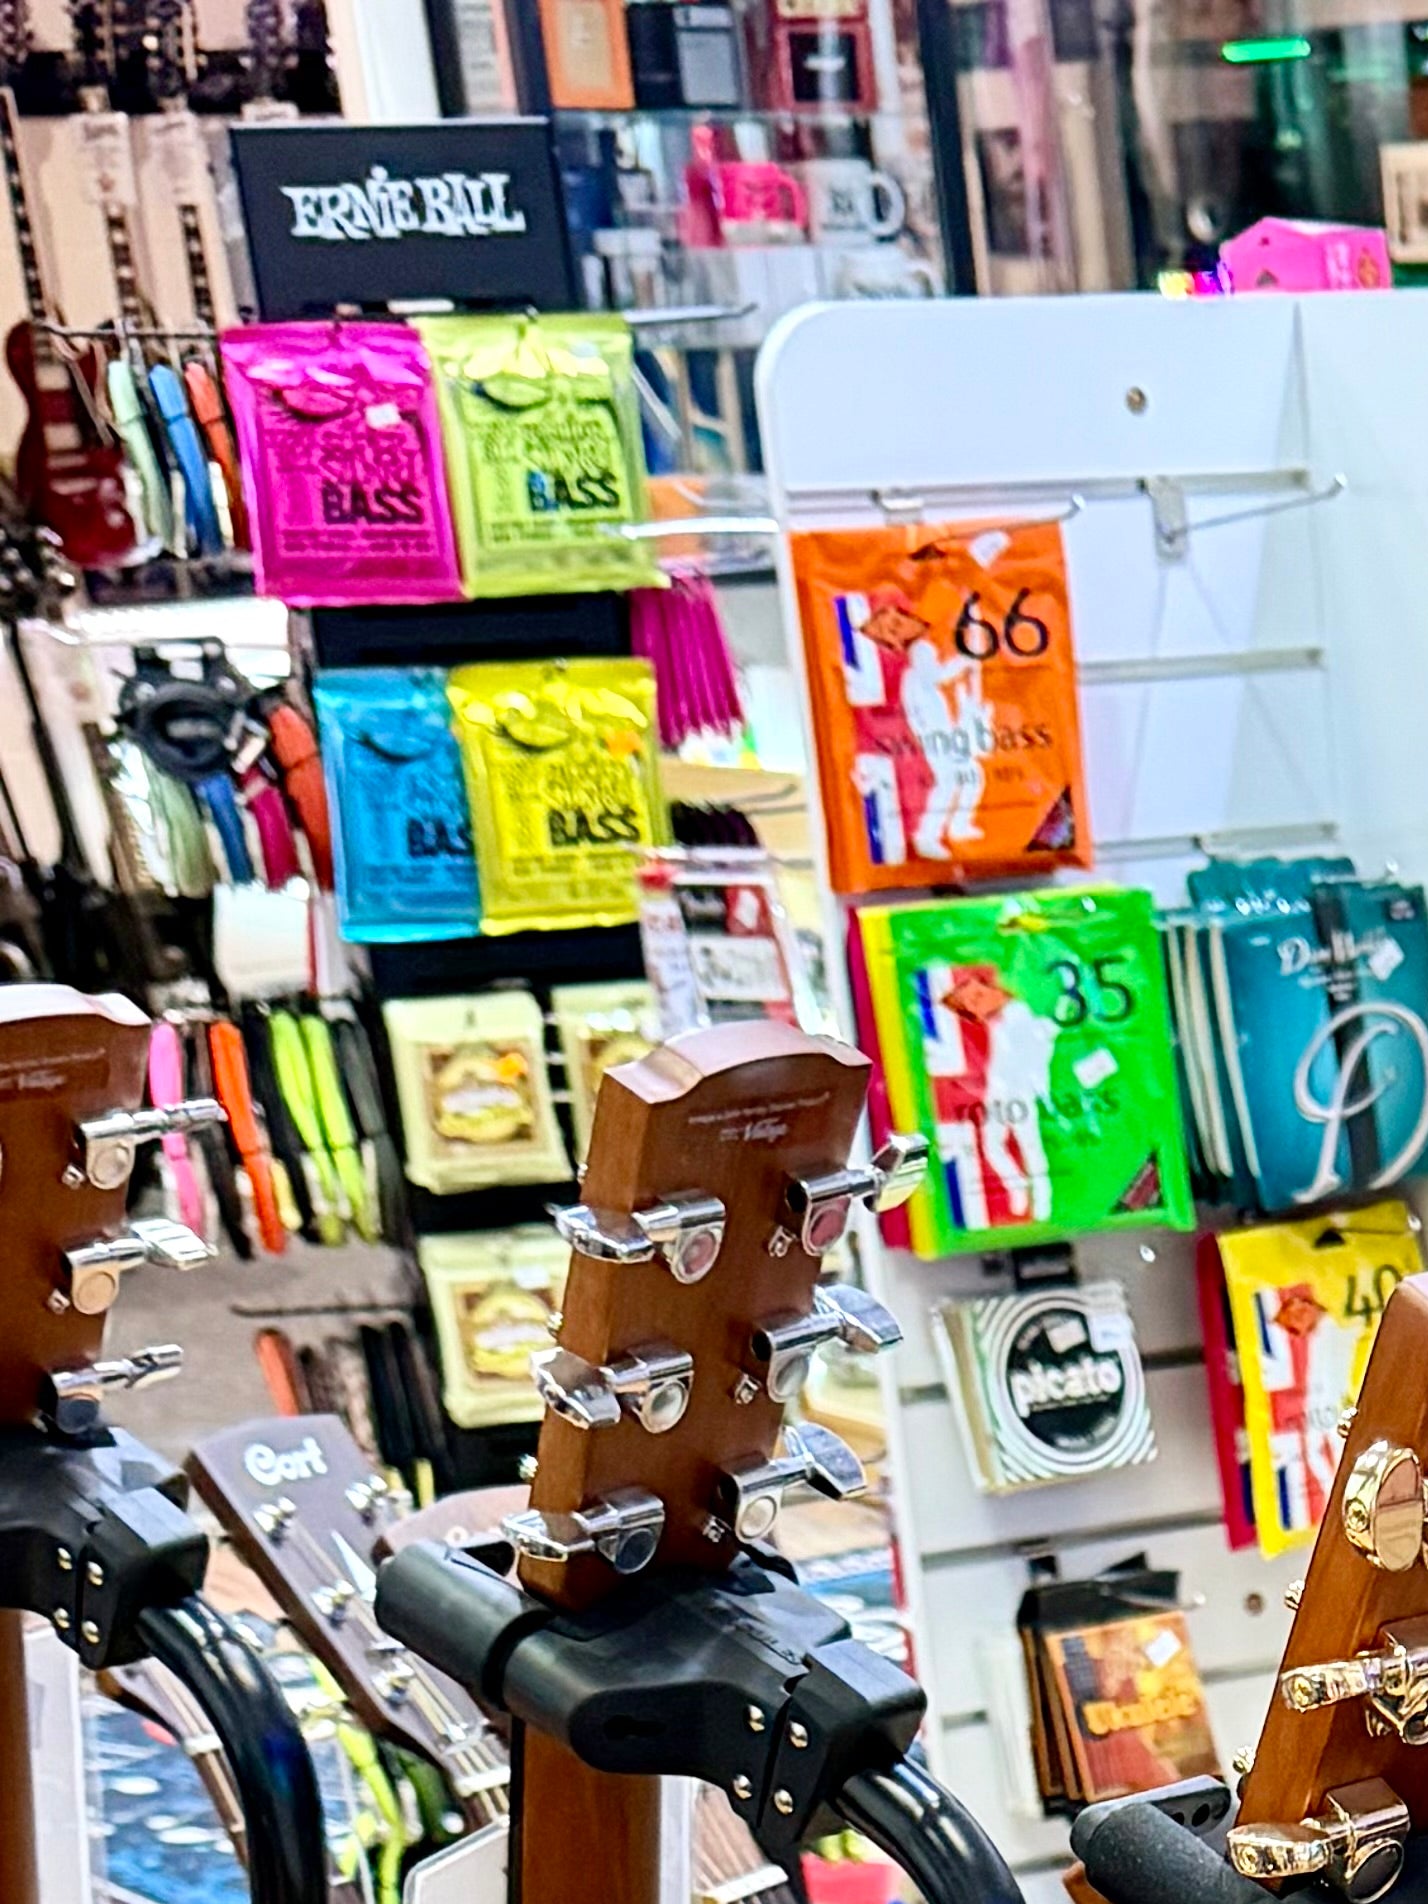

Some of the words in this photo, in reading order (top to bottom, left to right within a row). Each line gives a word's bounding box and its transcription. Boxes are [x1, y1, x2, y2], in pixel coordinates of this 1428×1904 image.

[279, 165, 413, 240] ERNIE
[415, 172, 527, 237] BALL
[321, 479, 425, 526] BASS
[529, 471, 621, 512] BASS
[955, 587, 1049, 660] 66
[406, 817, 474, 858] BAS
[547, 806, 641, 847] BASS
[1045, 954, 1132, 1029] 35
[1008, 1354, 1122, 1419] picato
[243, 1435, 329, 1487] Cort
